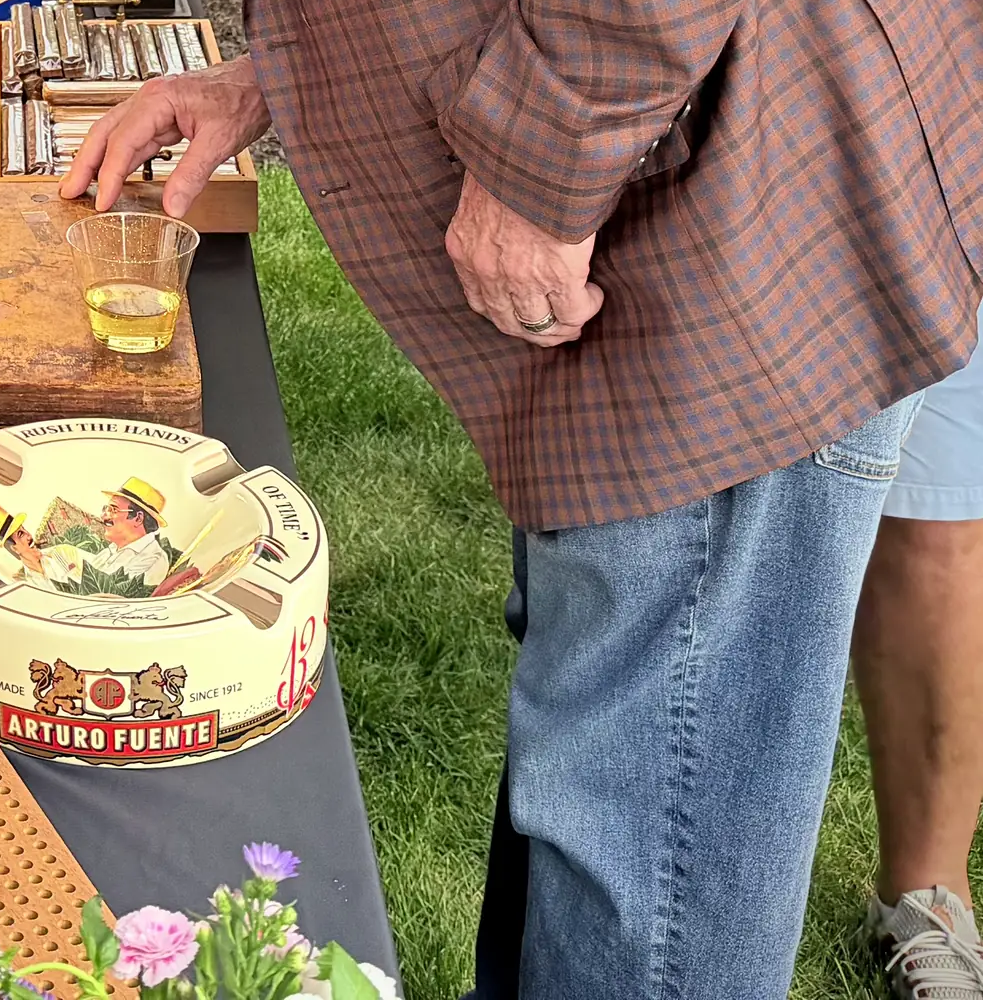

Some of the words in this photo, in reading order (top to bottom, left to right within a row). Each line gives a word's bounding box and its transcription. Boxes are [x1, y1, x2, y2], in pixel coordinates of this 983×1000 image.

[20, 423, 73, 439] RUSH
[76, 422, 118, 433] THE
[124, 424, 192, 446] HANDS
[262, 485, 287, 501] OF
[189, 689, 220, 704] SINCE
[221, 681, 243, 696] 1912
[7, 713, 107, 751] ARTURO
[114, 719, 212, 752] FUENTE
